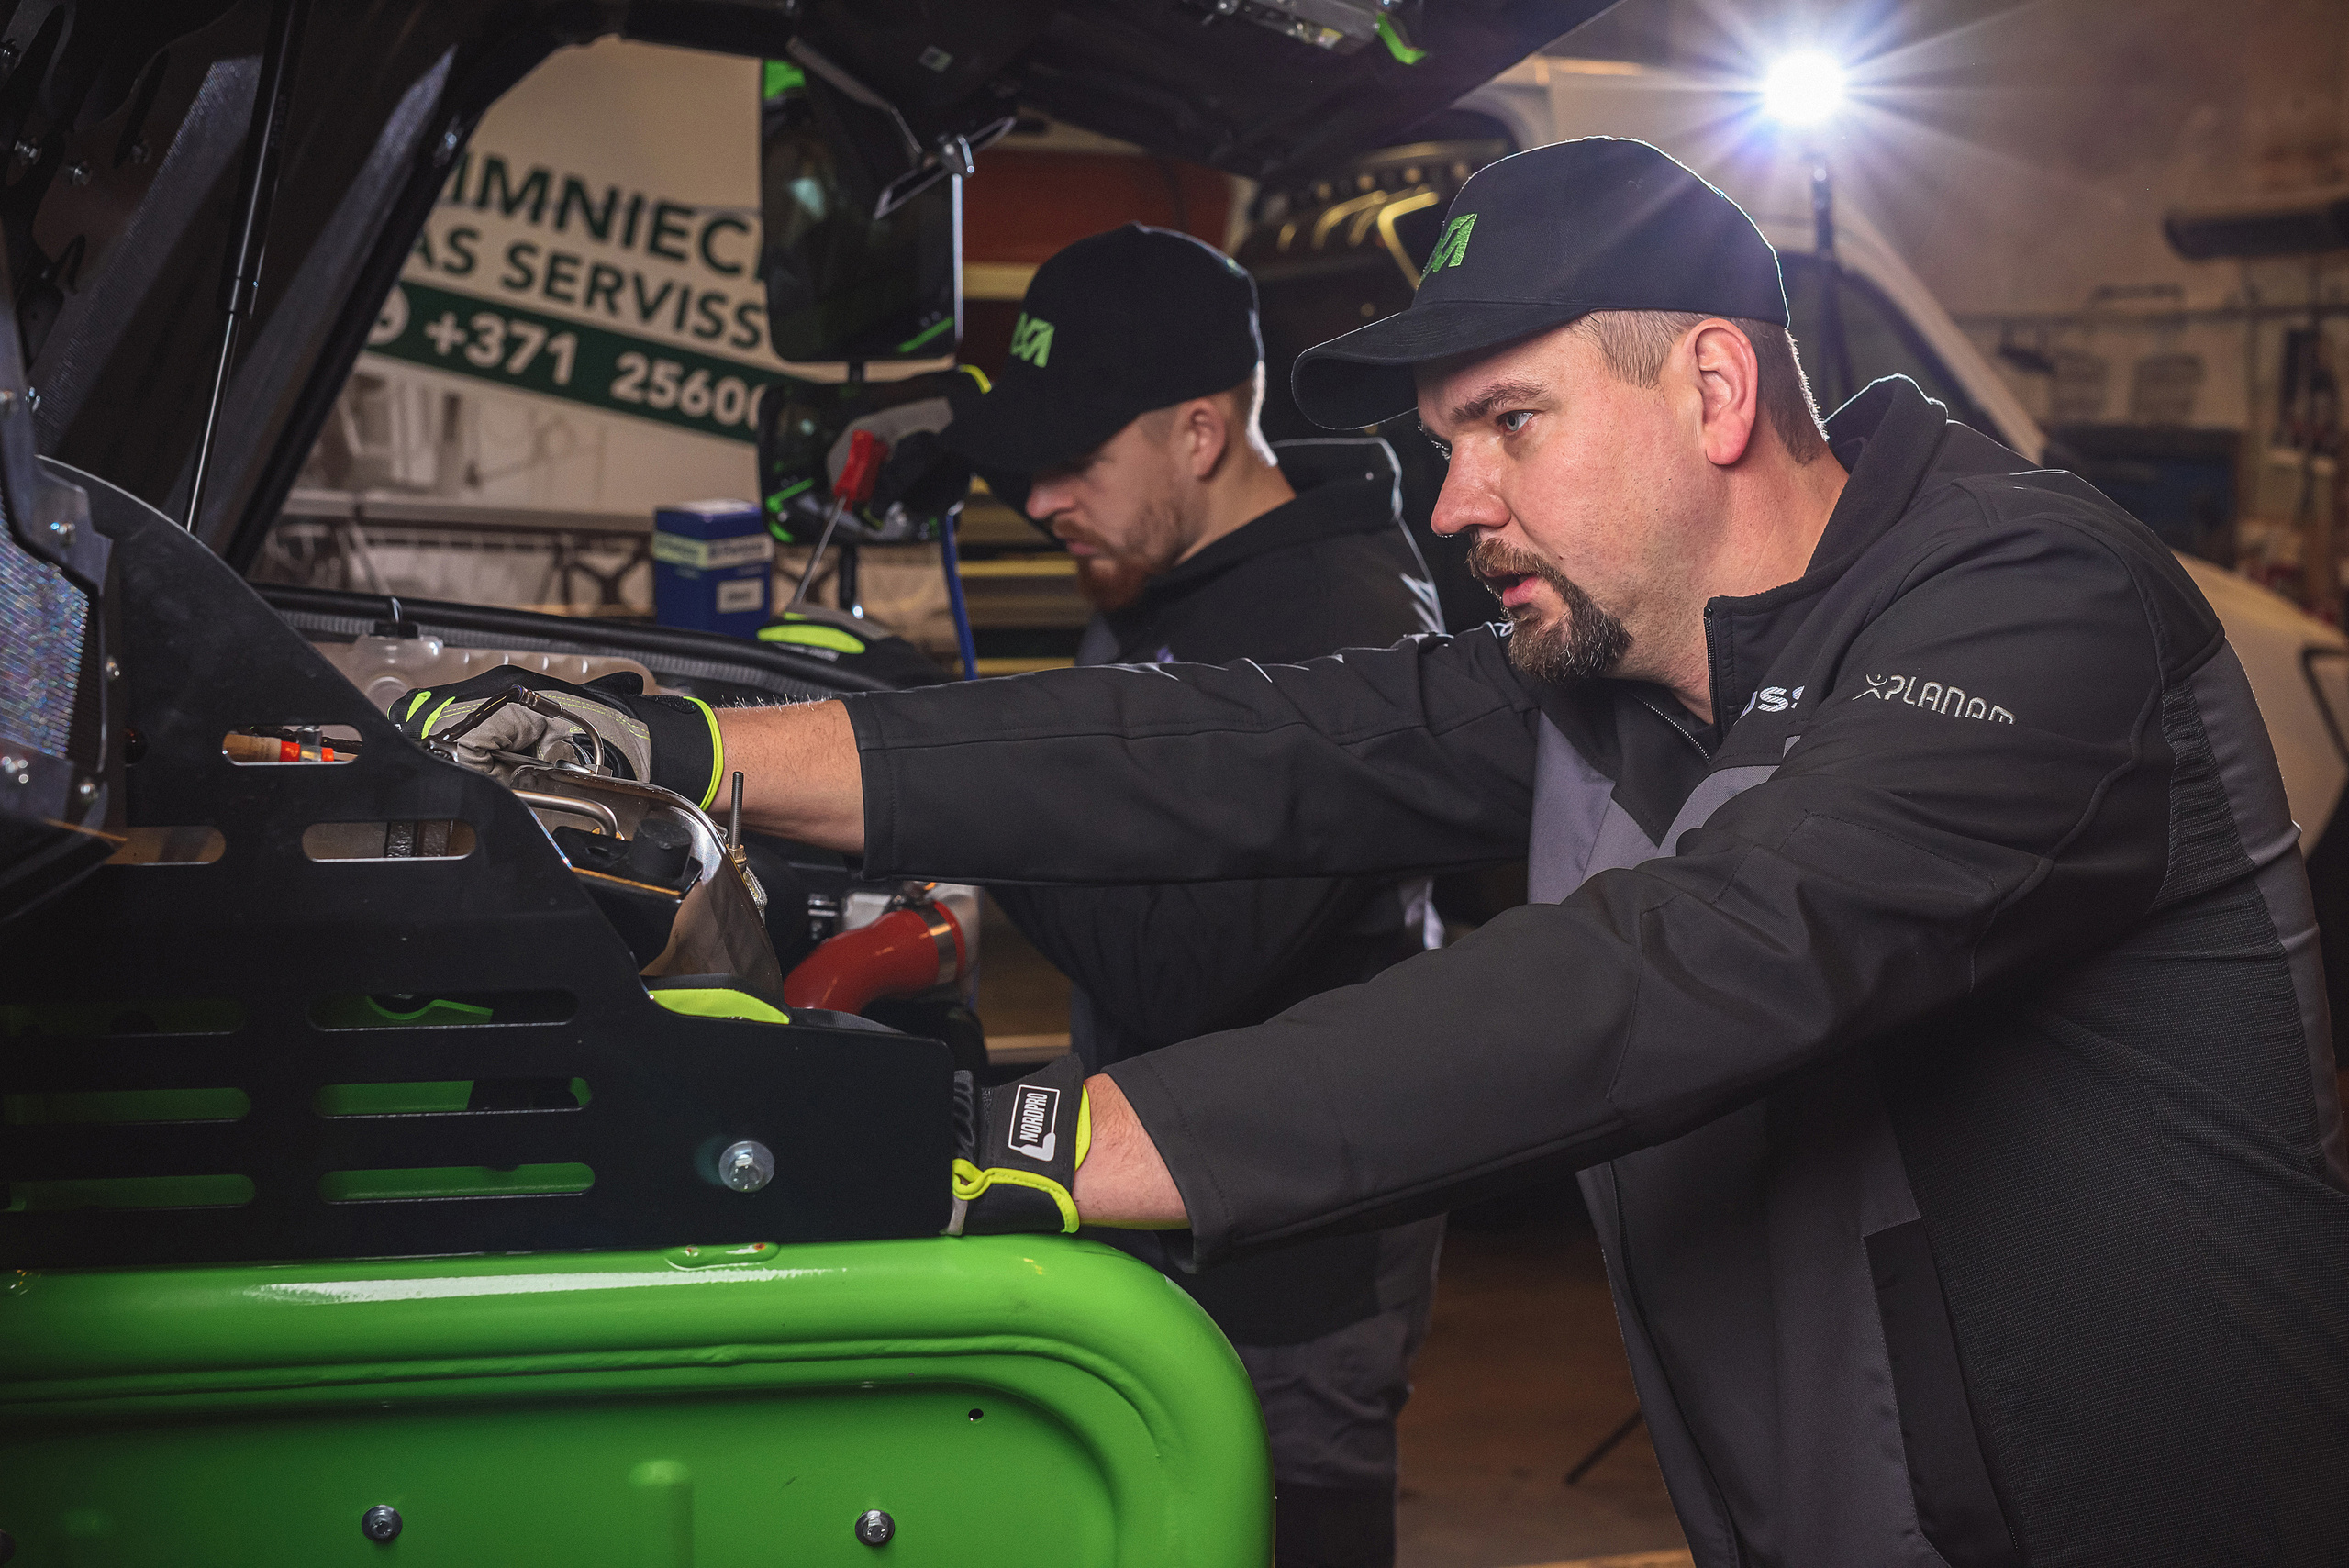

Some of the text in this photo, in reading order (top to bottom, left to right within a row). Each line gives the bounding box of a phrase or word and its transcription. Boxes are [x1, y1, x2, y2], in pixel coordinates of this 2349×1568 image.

[451, 150, 763, 281] IMNIEC
[501, 241, 764, 350] SERVISS
[424, 310, 579, 386] +371
[1019, 1092, 1048, 1143] NORDPRO
